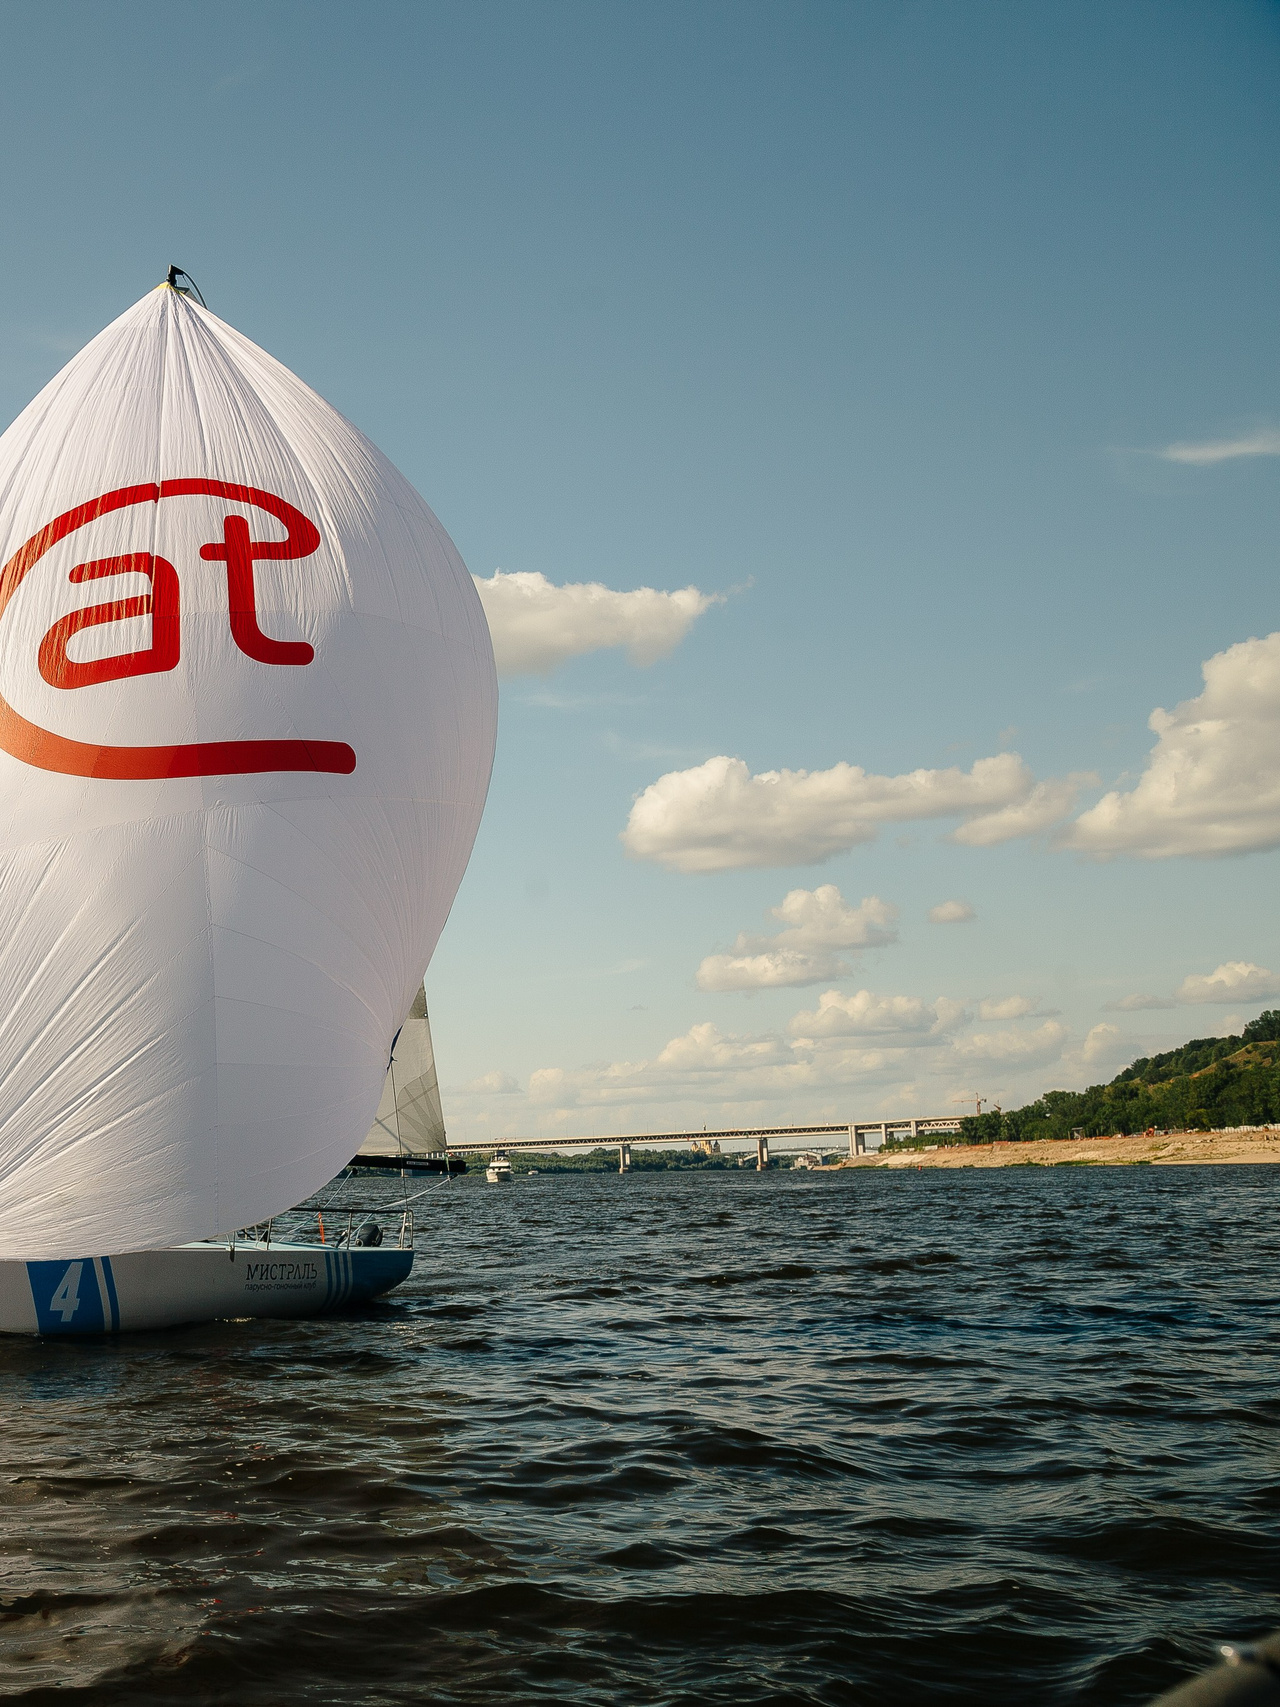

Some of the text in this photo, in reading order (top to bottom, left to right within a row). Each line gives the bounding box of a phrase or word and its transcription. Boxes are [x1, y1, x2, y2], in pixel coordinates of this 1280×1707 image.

[246, 1263, 318, 1280] МИСТРАЛЬ
[50, 1262, 83, 1322] 4
[244, 1280, 317, 1292] парусно-гоночный клуб
